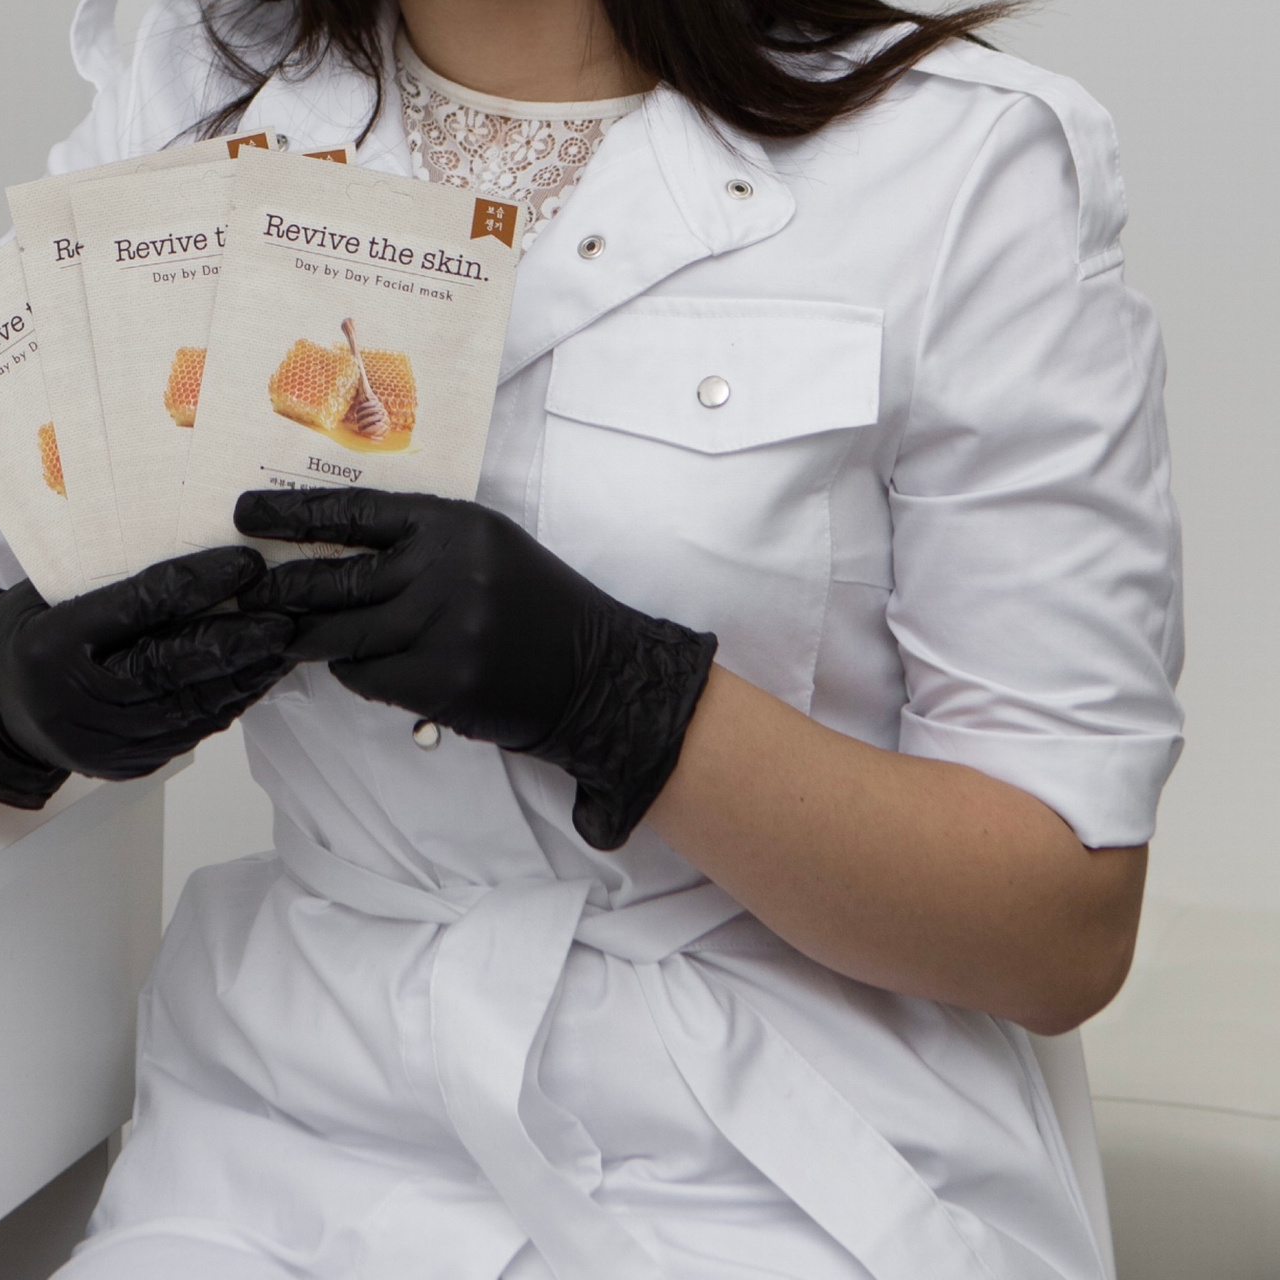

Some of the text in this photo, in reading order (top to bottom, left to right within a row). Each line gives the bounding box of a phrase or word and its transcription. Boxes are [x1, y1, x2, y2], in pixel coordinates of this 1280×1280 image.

[114, 233, 208, 262] Revive
[263, 214, 489, 282] Revive the skin.
[152, 265, 222, 283] Day by Da
[295, 258, 453, 301] Day by Day Facial mask
[11, 351, 27, 364] by
[307, 456, 363, 483] Honey
